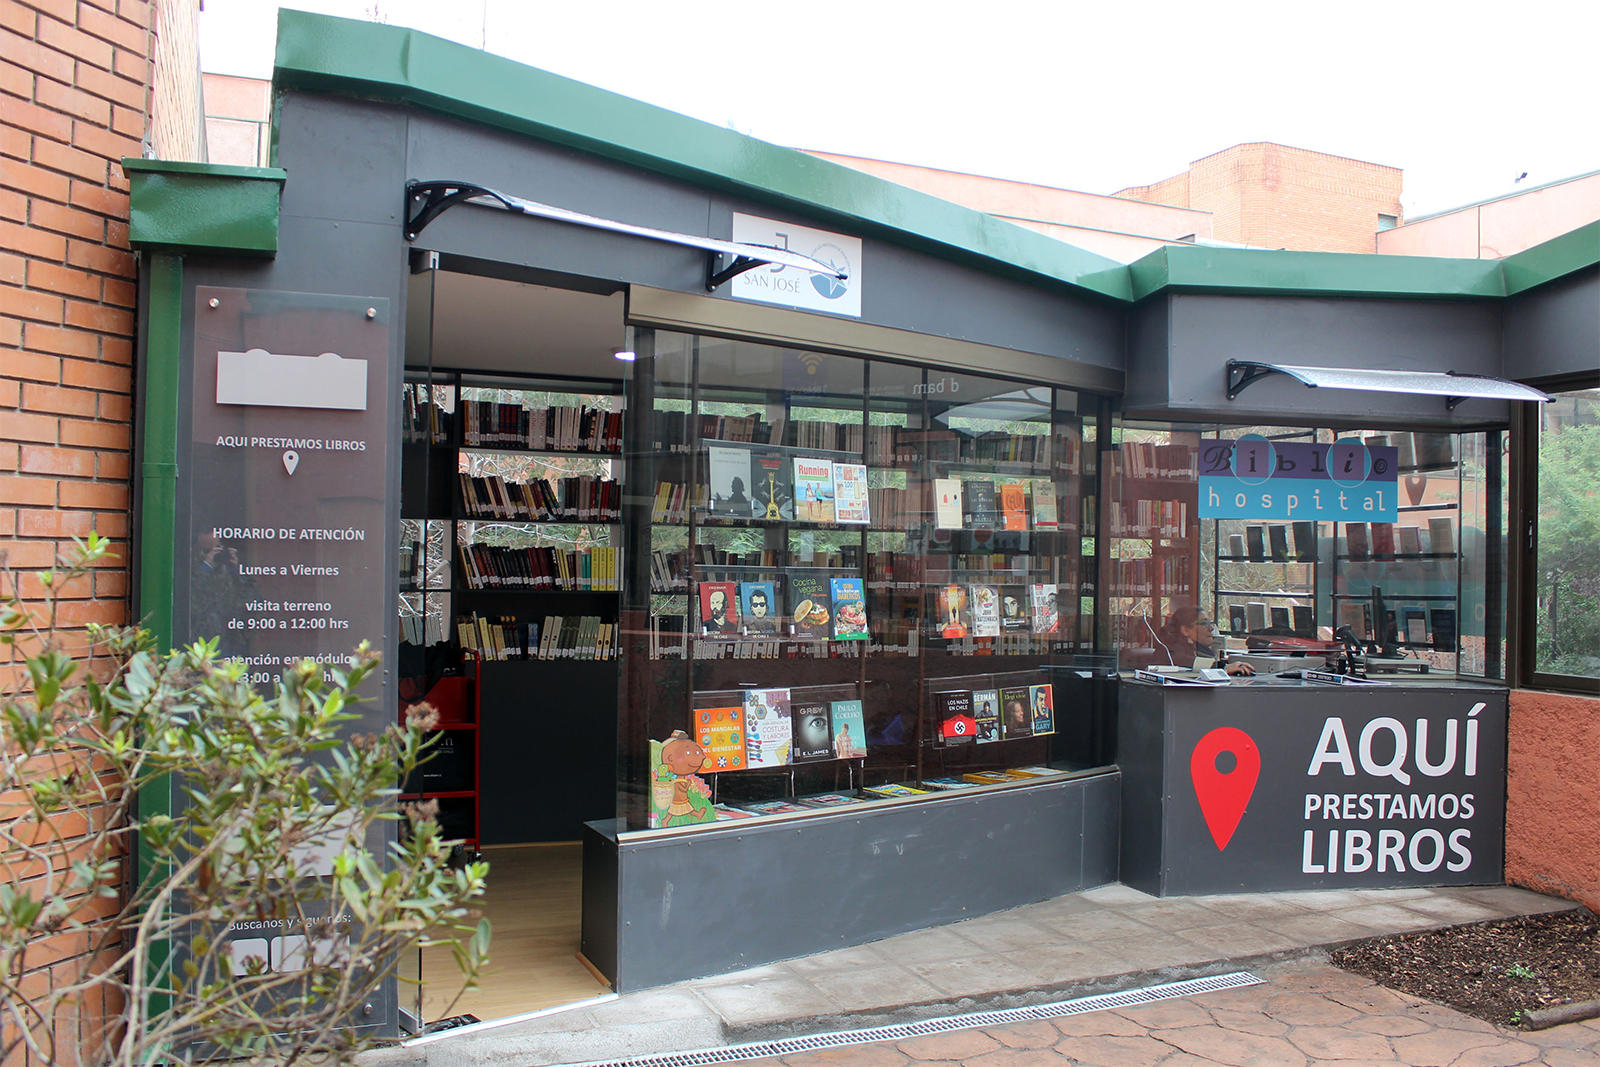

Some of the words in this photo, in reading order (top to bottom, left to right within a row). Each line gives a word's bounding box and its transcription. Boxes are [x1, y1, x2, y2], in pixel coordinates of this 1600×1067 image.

[744, 272, 769, 288] SAN
[772, 277, 800, 294] JOSÉ
[216, 435, 248, 448] AQUI
[251, 437, 322, 450] PRESTAMOS
[325, 439, 366, 451] LIBROS
[798, 464, 829, 478] Running
[1208, 486, 1386, 516] hospital
[212, 527, 276, 539] HORARIO
[278, 528, 296, 540] DE
[299, 526, 365, 540] ATENCIÓN
[239, 564, 276, 576] Lunes
[280, 566, 288, 576] a
[291, 564, 339, 576] Viernes
[793, 578, 816, 587] Cocina
[798, 584, 823, 595] vegana
[246, 600, 280, 612] visita
[284, 602, 332, 612] terreno
[228, 618, 244, 630] de
[248, 618, 276, 630] 9:00
[279, 620, 287, 630] a
[290, 618, 326, 630] 12:00
[329, 618, 348, 630] hrs
[224, 654, 280, 665] atención
[284, 656, 300, 665] en
[304, 653, 352, 664] módulo
[236, 672, 270, 683] 3:00
[273, 674, 280, 683] a
[974, 692, 996, 702] GERMÁN
[800, 706, 823, 715] GREY
[1307, 702, 1487, 786] AQUÍ
[1304, 794, 1475, 820] PRESTAMOS
[1302, 828, 1472, 874] LIBROS
[287, 918, 293, 928] y
